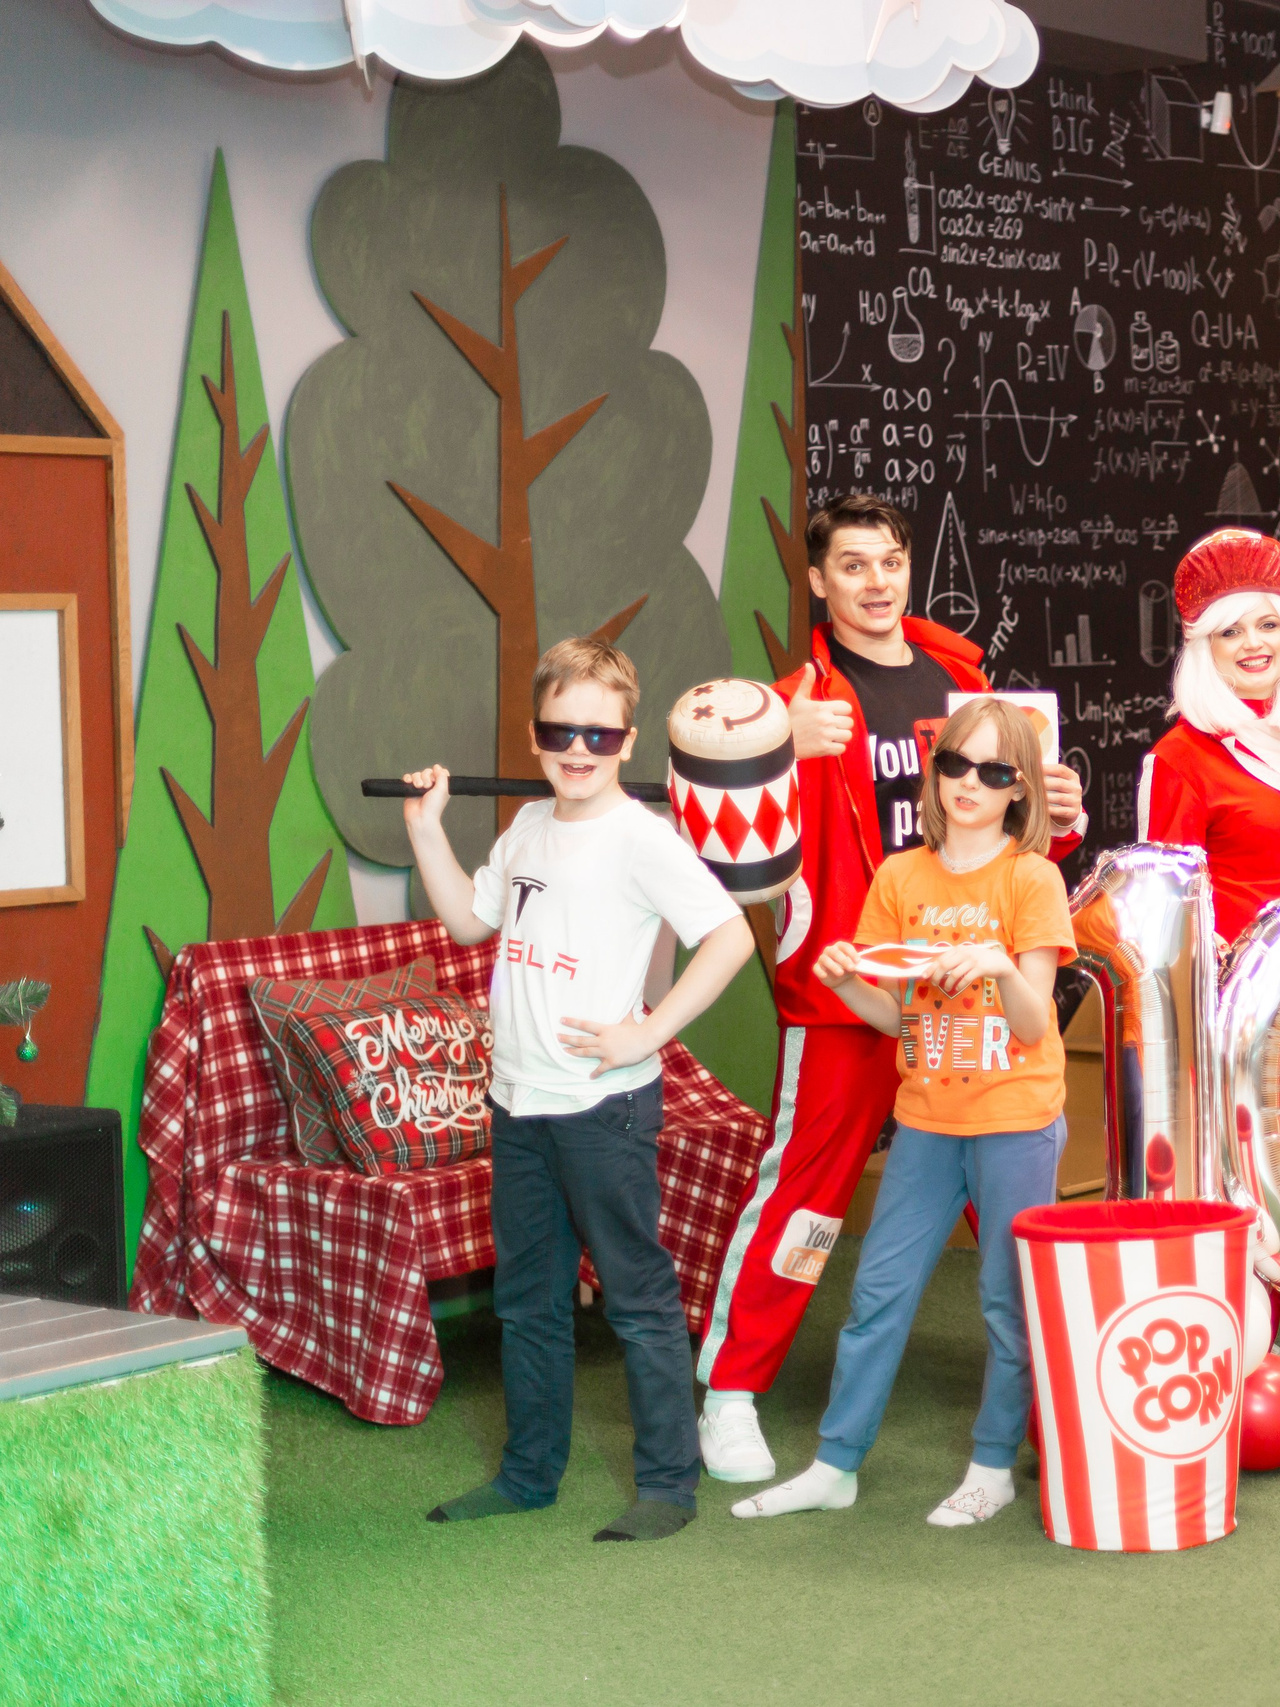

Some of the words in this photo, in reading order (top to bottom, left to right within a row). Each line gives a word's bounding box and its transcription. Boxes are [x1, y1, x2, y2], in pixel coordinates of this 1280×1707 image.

[1047, 77, 1099, 115] think
[1052, 115, 1094, 155] BIG
[979, 151, 1041, 183] GENIUS
[1069, 287, 1082, 316] A
[922, 902, 991, 928] never
[345, 1009, 475, 1071] Merry
[901, 1013, 1011, 1072] EVER
[371, 1057, 489, 1133] Christma
[805, 1220, 835, 1250] You
[787, 1251, 824, 1278] Tube
[1117, 1317, 1210, 1388] POP
[1133, 1347, 1233, 1434] CORN
